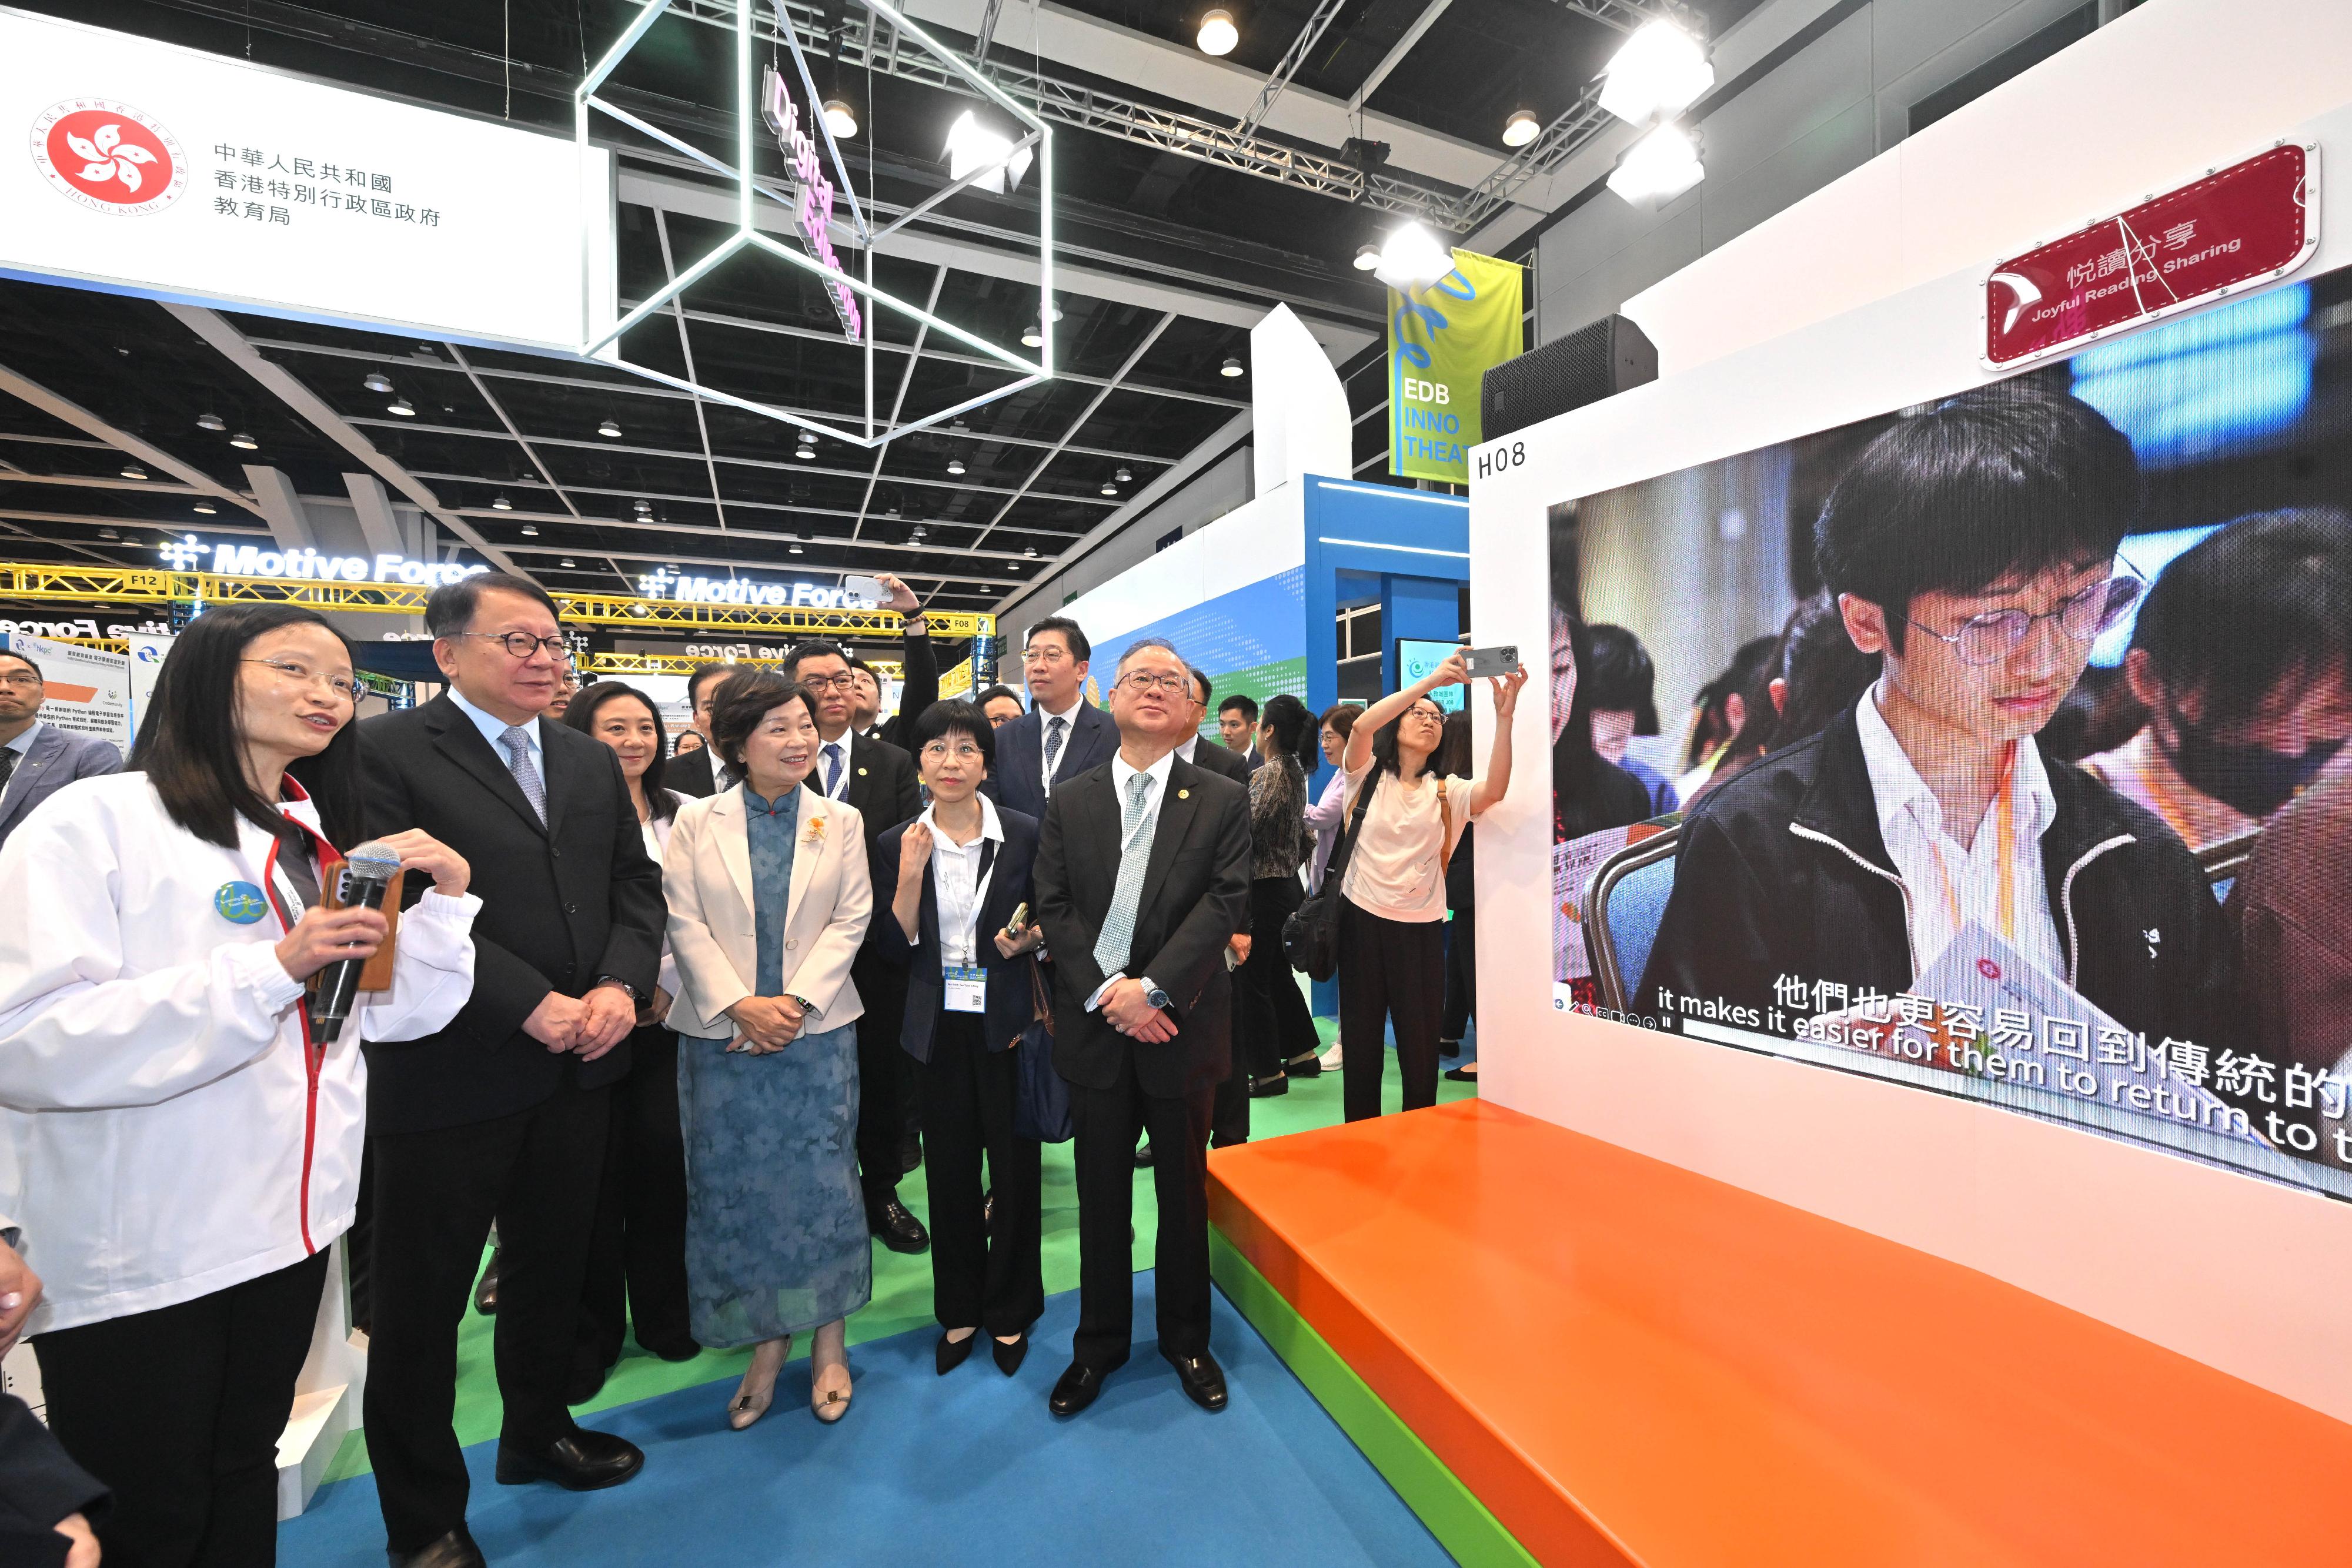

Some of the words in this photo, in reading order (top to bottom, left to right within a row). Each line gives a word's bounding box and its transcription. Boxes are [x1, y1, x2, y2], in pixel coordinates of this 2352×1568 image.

[214, 143, 392, 193] 中華人民共和國
[65, 188, 111, 212] HONG
[118, 202, 159, 214] KONG
[213, 195, 290, 226] 教育局
[214, 169, 440, 227] 香港特別行政區政府
[2032, 295, 2080, 322] Joyful
[2085, 268, 2157, 303] Reading
[2163, 238, 2241, 273] Sharing
[1404, 377, 1449, 405] EDB
[1405, 406, 1459, 434] INNO
[212, 544, 368, 582] Motive
[131, 575, 157, 586] F12
[675, 576, 787, 605] Motive
[36, 644, 51, 654] hkpc
[1658, 987, 1674, 1011] it
[1680, 992, 1760, 1028] makes
[1768, 1006, 1786, 1034] it
[1793, 1018, 1883, 1051] easier
[1891, 1028, 1939, 1062] for
[1949, 1039, 2044, 1085] them
[2057, 1063, 2097, 1095] to
[2113, 1080, 2250, 1135] return
[2264, 1111, 2317, 1151] to
